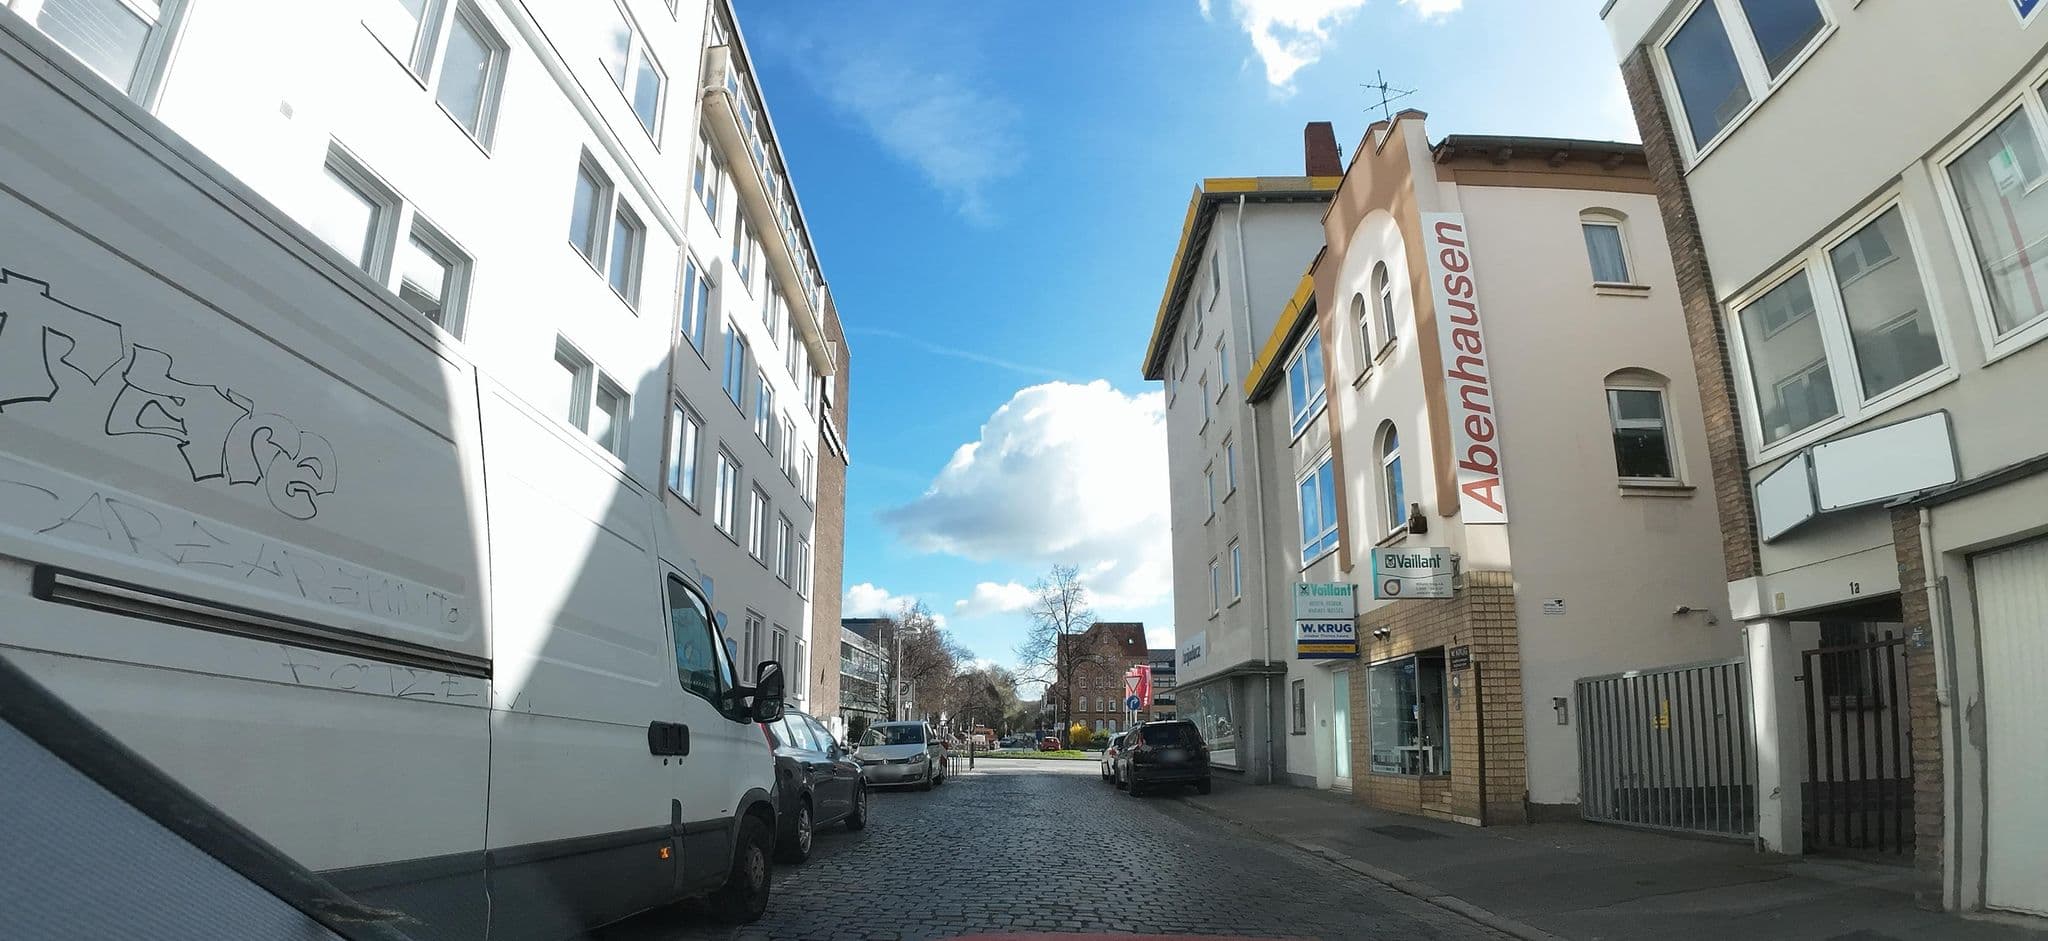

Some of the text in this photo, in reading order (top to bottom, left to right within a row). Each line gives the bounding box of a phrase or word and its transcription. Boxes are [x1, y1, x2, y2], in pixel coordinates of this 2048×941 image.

[1434, 220, 1503, 514] Abenhausen
[1397, 553, 1442, 569] Vaillant
[1311, 583, 1351, 596] Vaillant
[1849, 581, 1860, 595] 1a
[1301, 623, 1352, 633] W. KRUG
